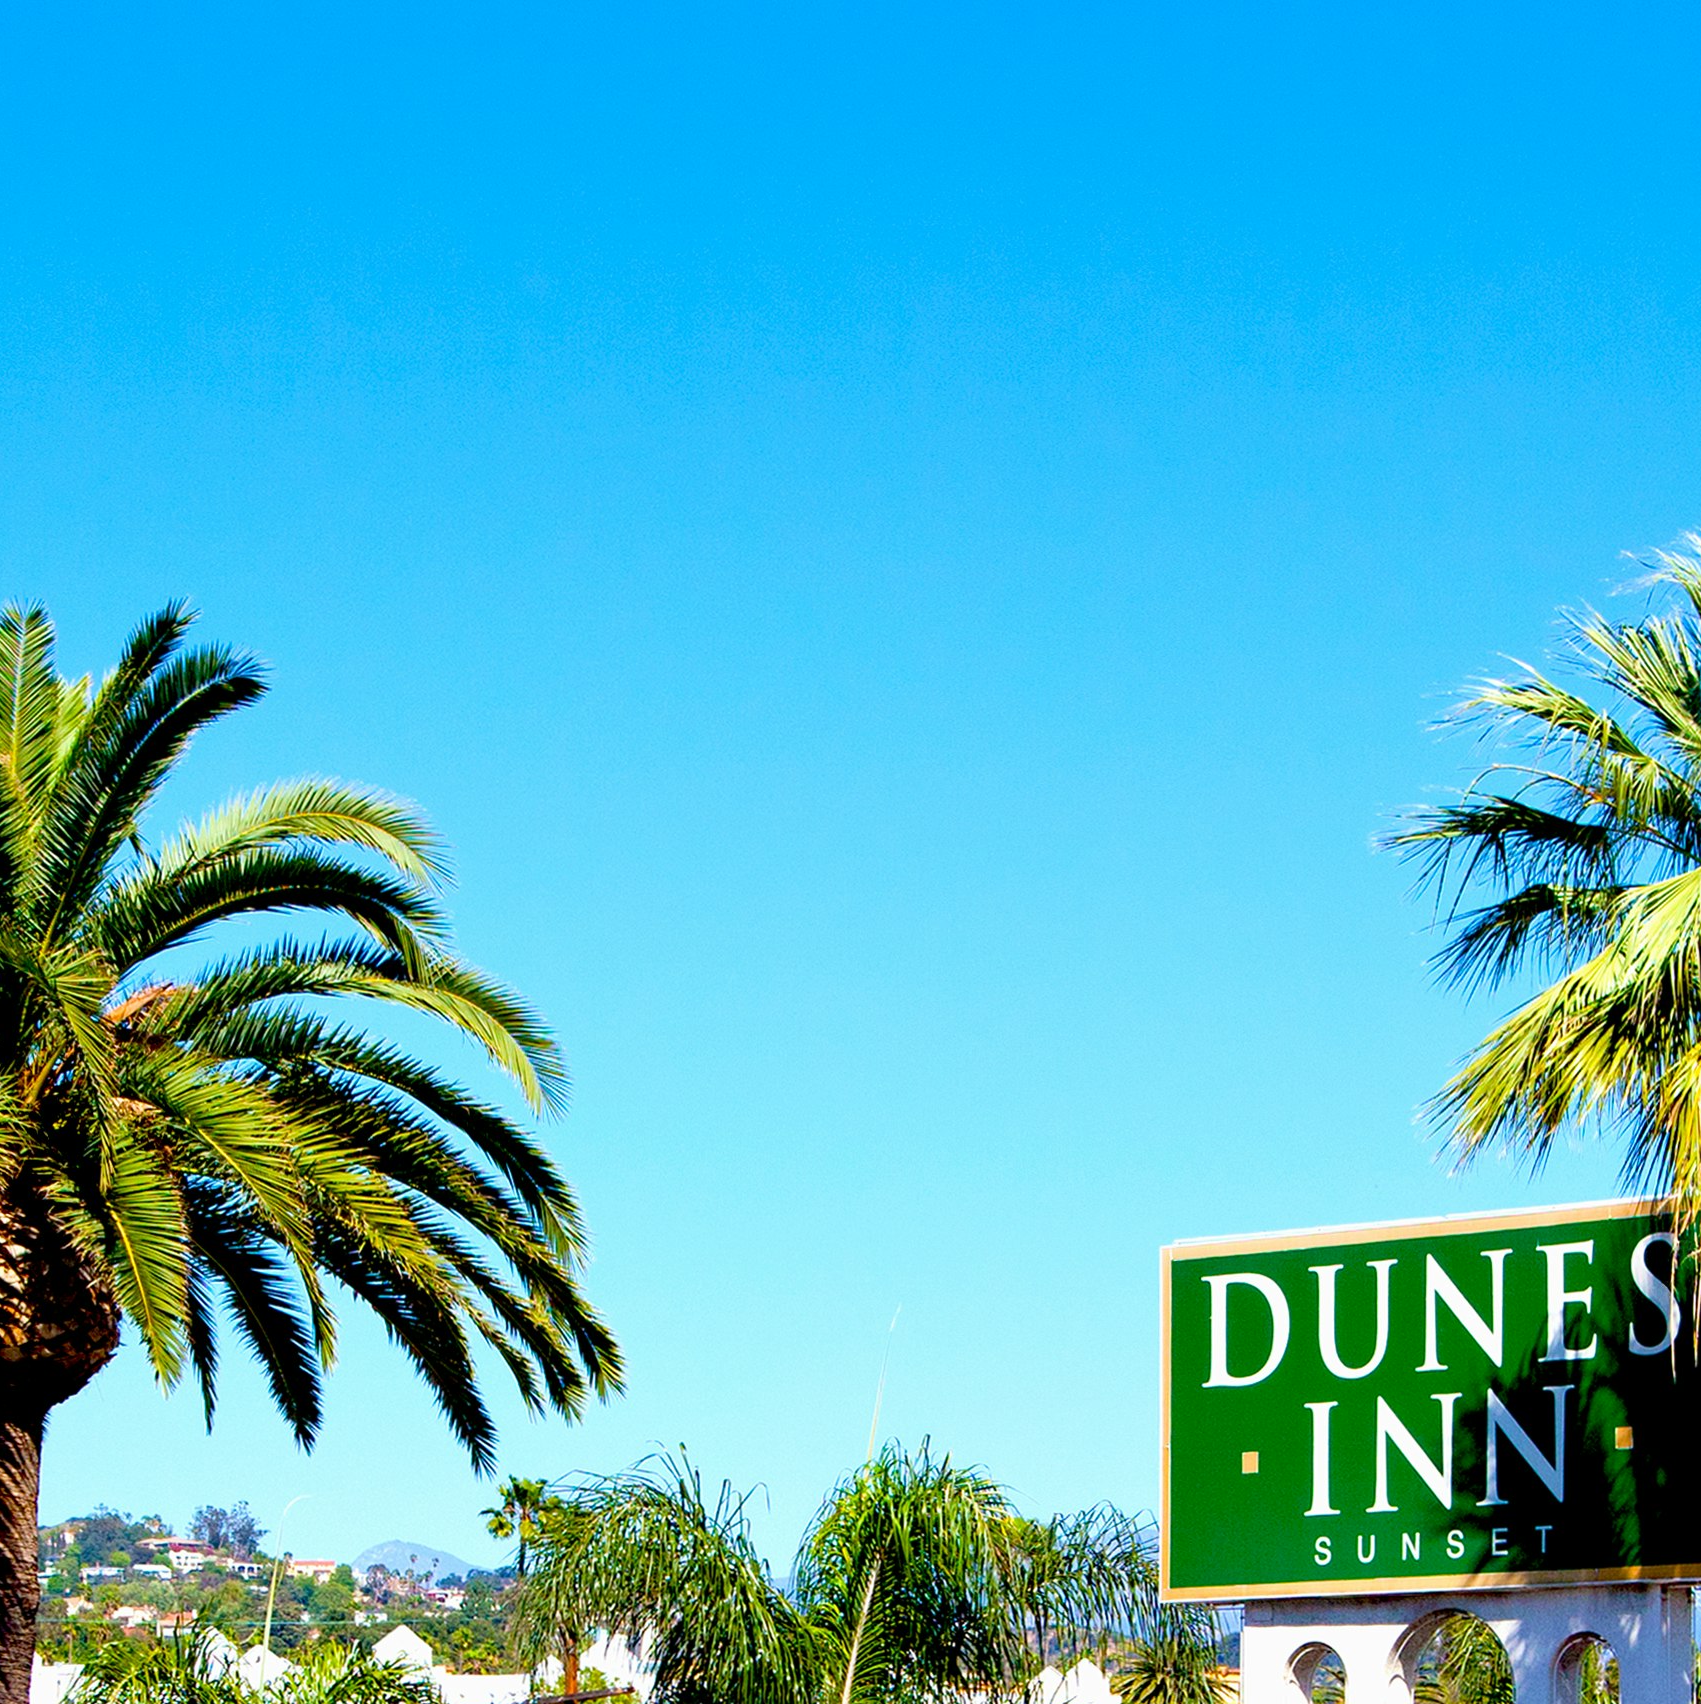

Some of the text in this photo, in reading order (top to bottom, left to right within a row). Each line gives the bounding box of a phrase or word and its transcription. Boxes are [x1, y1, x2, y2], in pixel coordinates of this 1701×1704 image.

[1201, 1231, 1681, 1388] DUNES
[1303, 1384, 1574, 1517] INN
[1313, 1525, 1553, 1566] SUNSET
